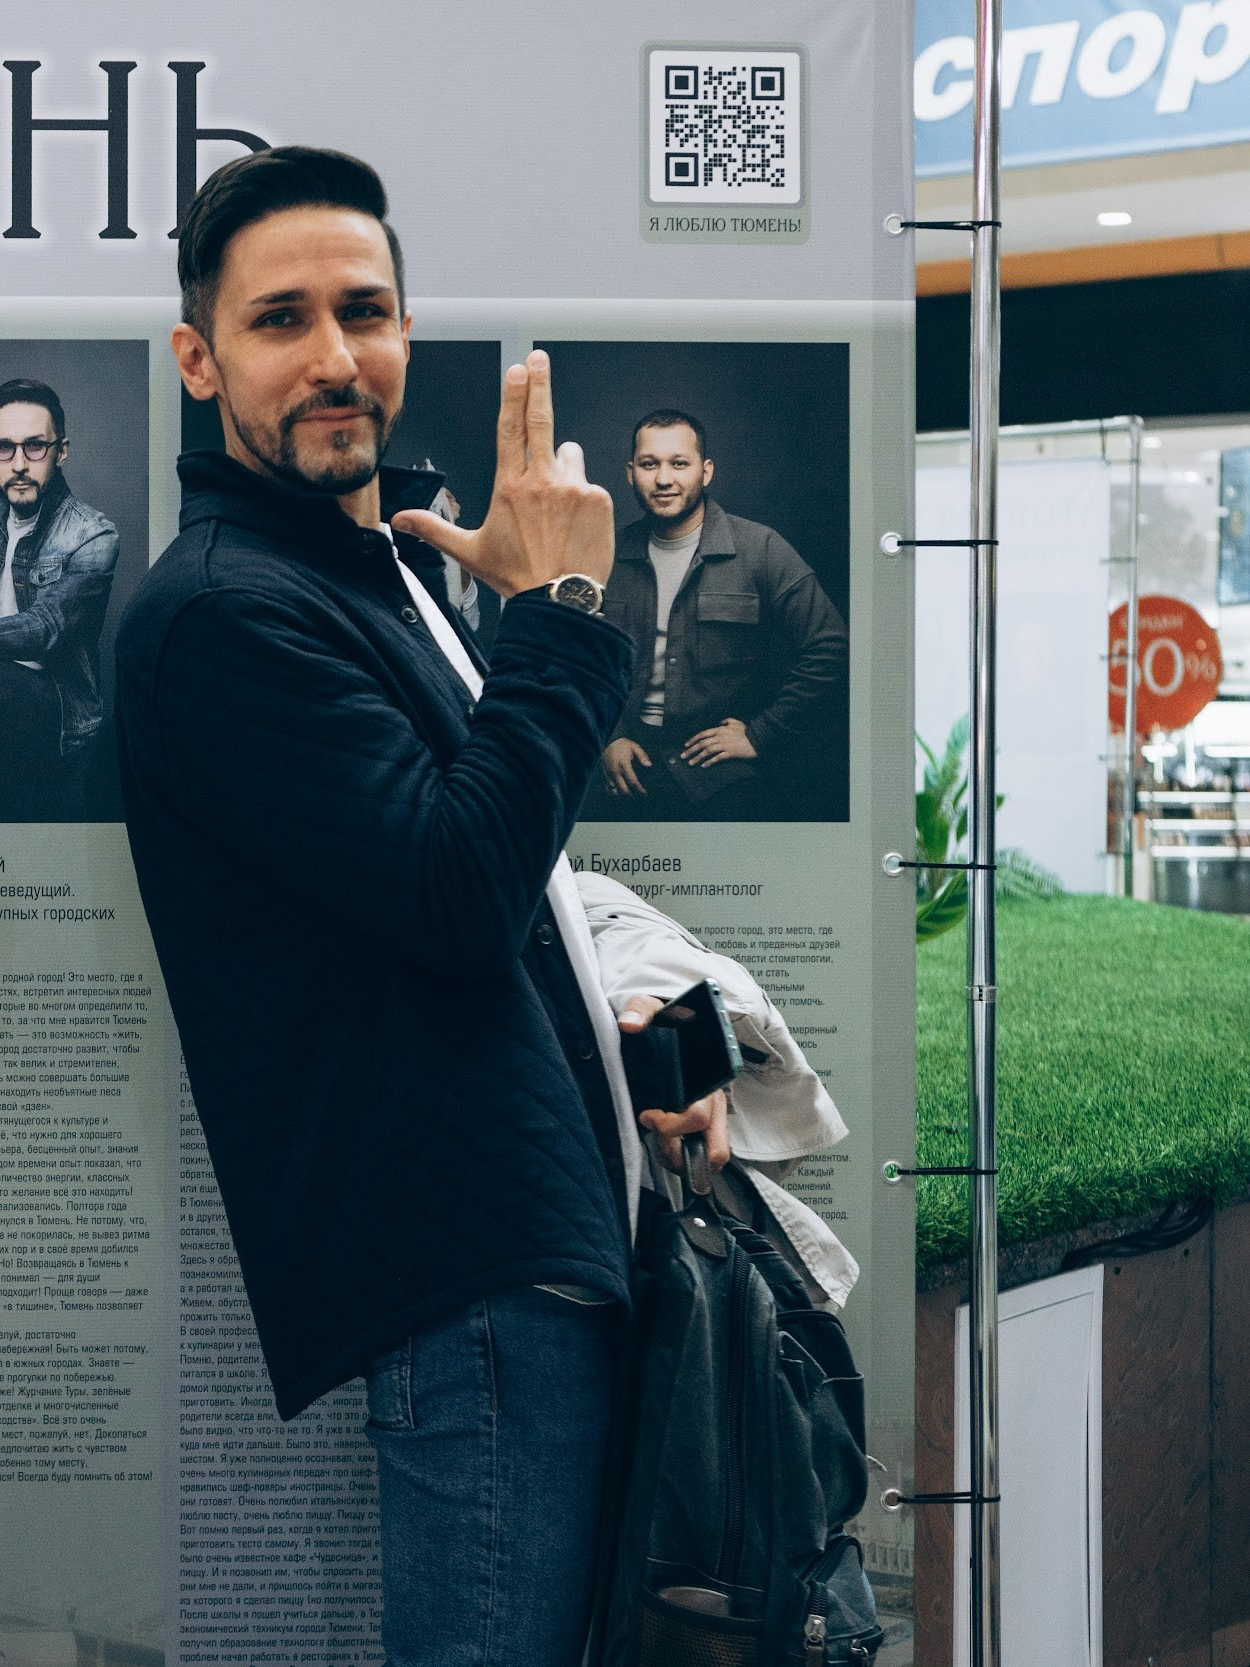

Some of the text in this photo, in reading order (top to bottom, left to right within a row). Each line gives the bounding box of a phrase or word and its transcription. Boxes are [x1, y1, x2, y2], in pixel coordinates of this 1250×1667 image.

[649, 217, 802, 232] Я ЛЮБЛЮ ТЮМЕНЬ!
[590, 854, 682, 876] Бухарбаев
[43, 908, 116, 924] городских
[703, 926, 834, 937] просто город, это место, где
[714, 939, 843, 951] любовь и преданных друзей.
[768, 955, 834, 964] стоматологии,
[23, 988, 65, 999] встретил
[66, 988, 120, 999] интересных
[122, 986, 152, 998] людей
[789, 998, 825, 1006] помочь.
[0, 1117, 52, 1128] тянущегося
[60, 1117, 101, 1128] культуре
[797, 1166, 834, 1178] Каждый
[787, 1181, 834, 1191] сомнений.
[66, 1201, 105, 1214] Полтора
[106, 1203, 127, 1213] года
[820, 1211, 849, 1221] город,
[24, 1331, 76, 1341] достаточно
